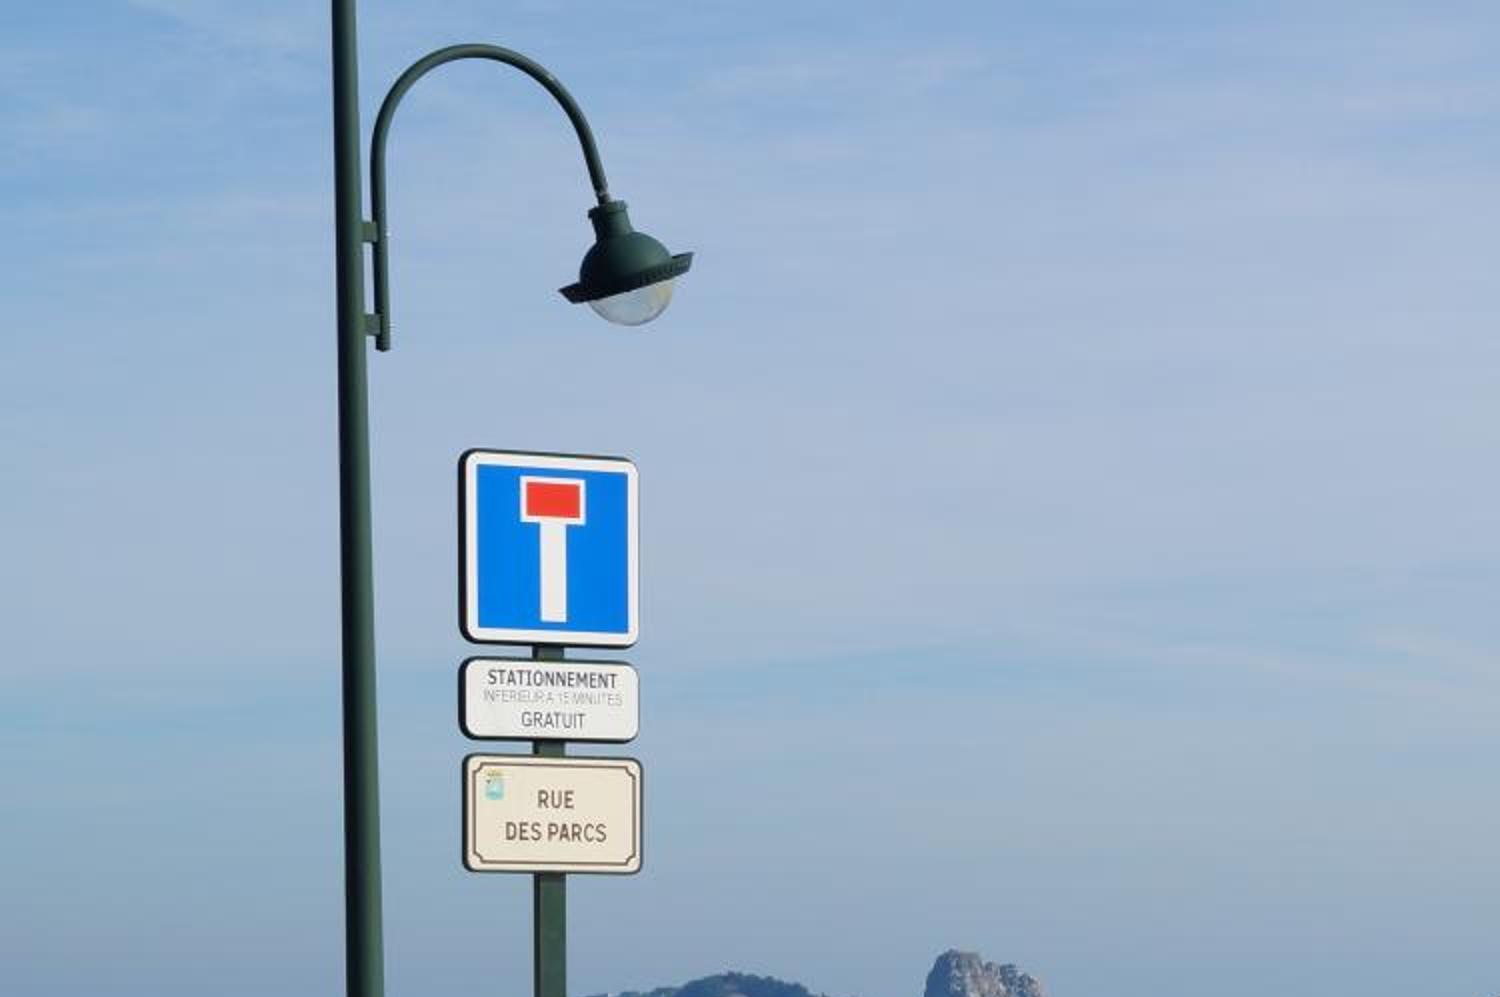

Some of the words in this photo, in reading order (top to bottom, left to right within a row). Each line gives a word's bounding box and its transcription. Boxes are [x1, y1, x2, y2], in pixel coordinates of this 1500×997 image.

[487, 669, 618, 689] STATIONNEMENT
[573, 692, 623, 707] MINUTES
[521, 711, 586, 729] GRATUIT
[537, 790, 575, 809] RUE
[505, 822, 542, 841] DES
[547, 823, 607, 843] PARCS
